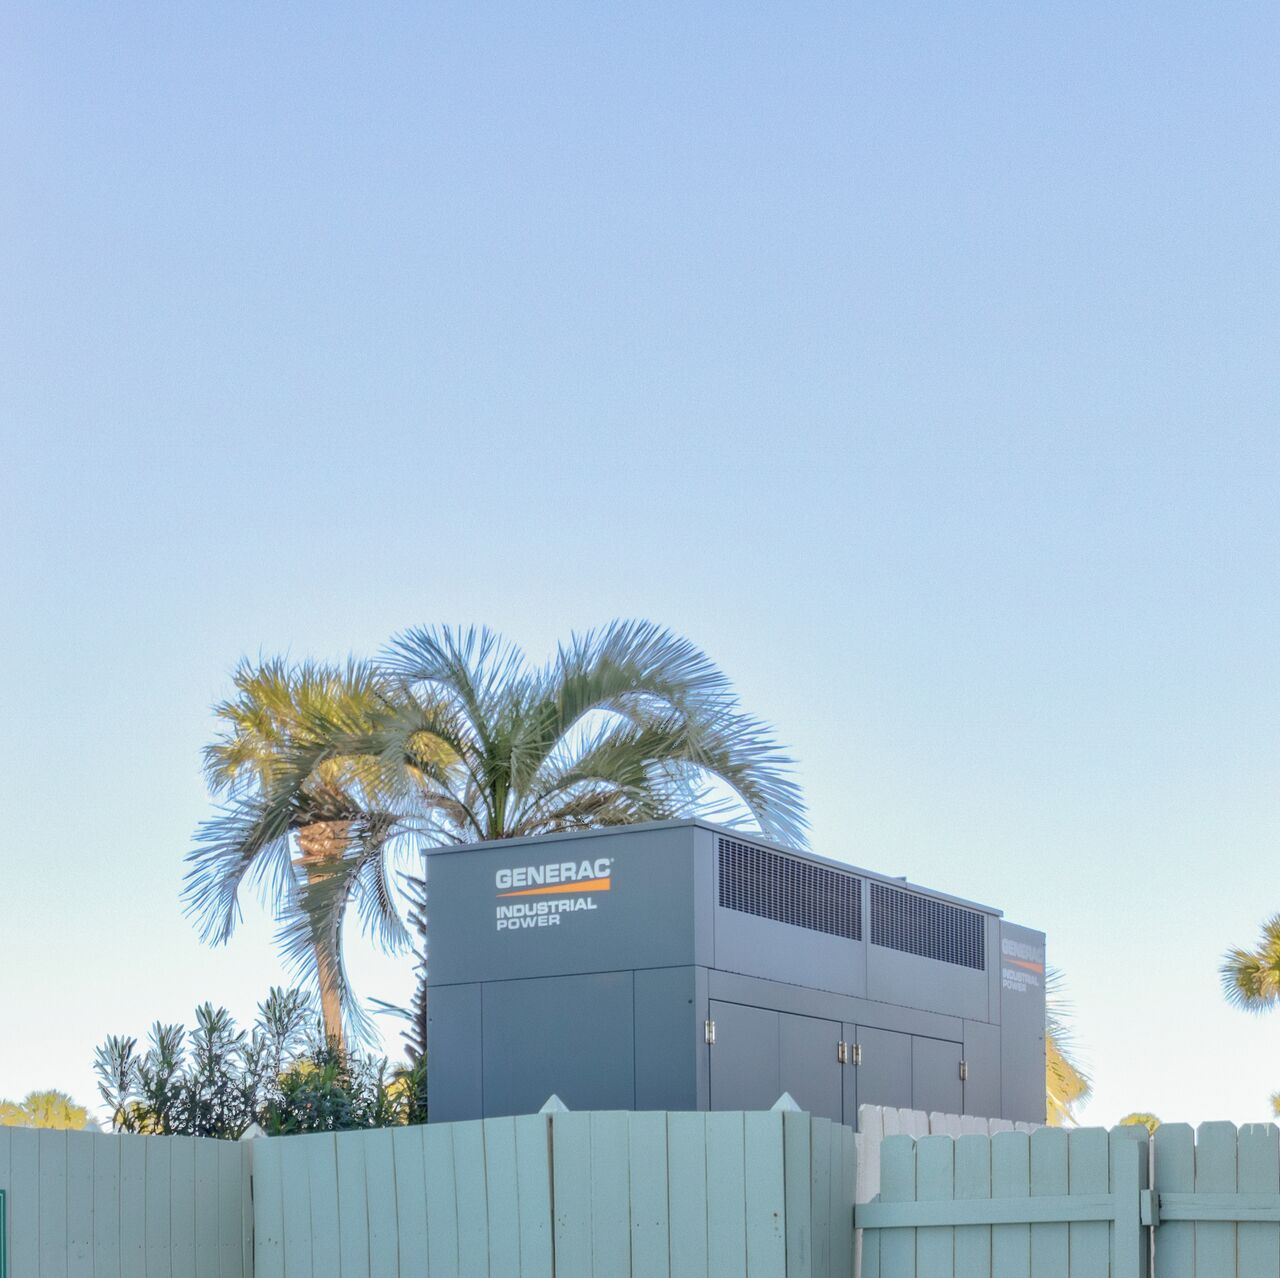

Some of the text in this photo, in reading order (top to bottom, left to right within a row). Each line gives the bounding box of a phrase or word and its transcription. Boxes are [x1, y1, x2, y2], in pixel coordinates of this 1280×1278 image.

[496, 858, 611, 889] GENERAC
[496, 897, 597, 919] INDUSTRIAL
[496, 914, 560, 931] POWER
[1002, 979, 1026, 992] POWER
